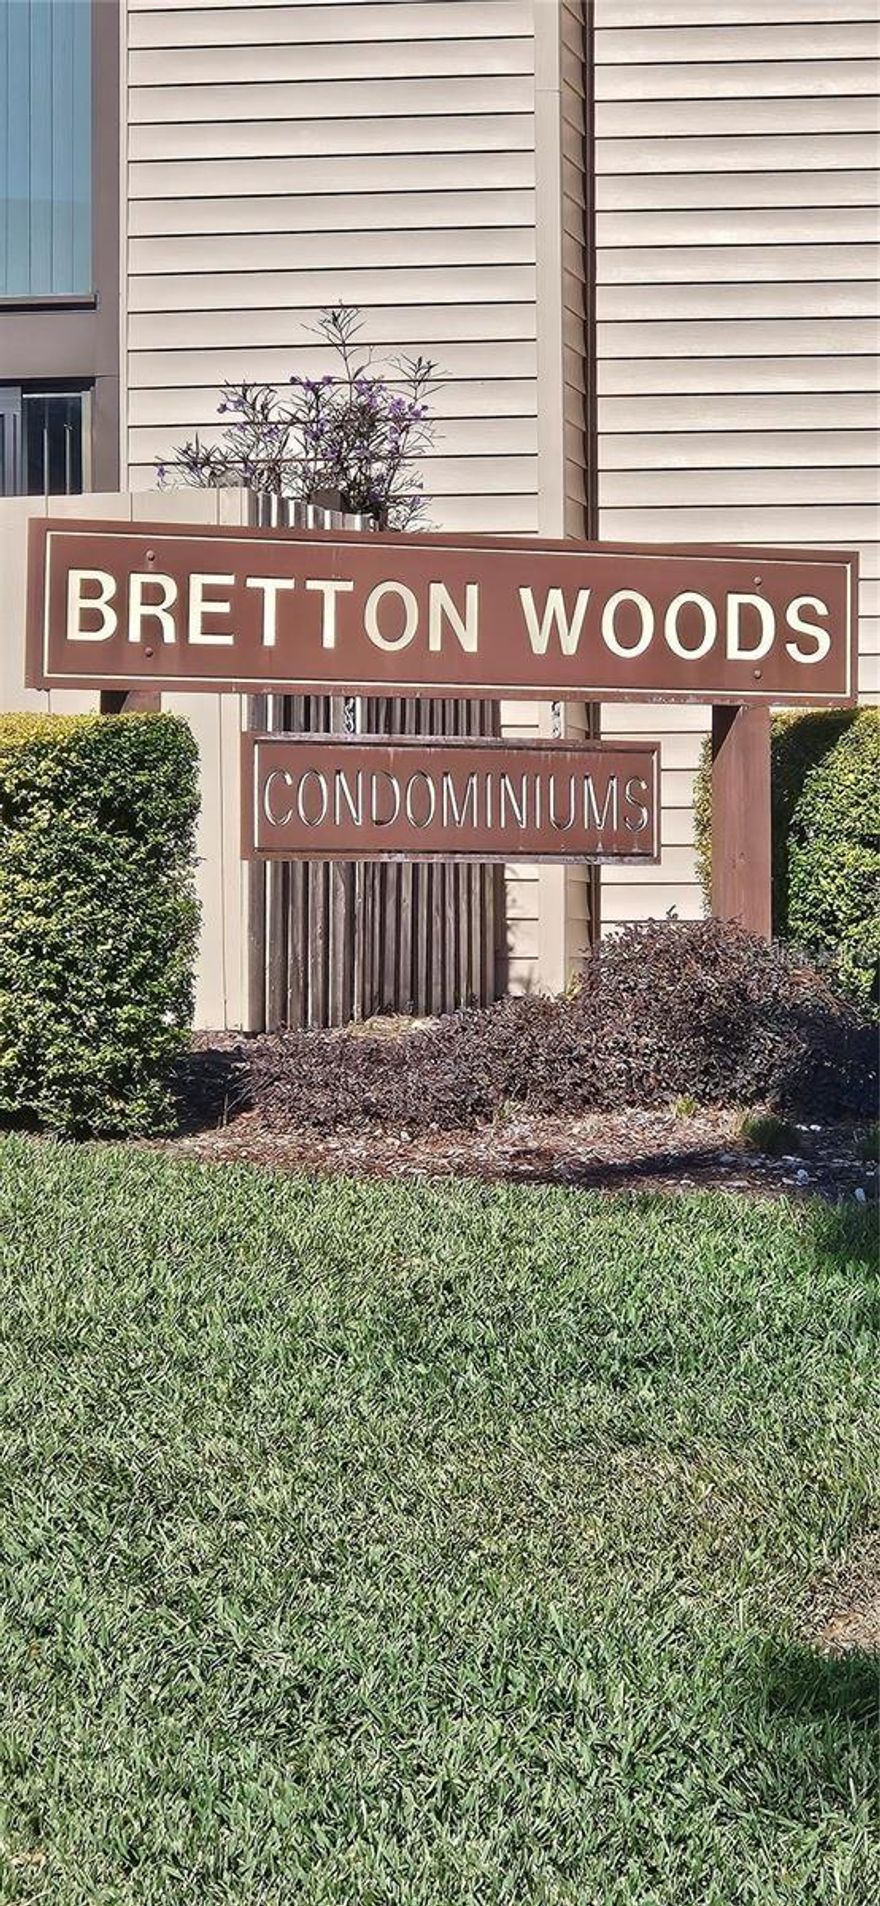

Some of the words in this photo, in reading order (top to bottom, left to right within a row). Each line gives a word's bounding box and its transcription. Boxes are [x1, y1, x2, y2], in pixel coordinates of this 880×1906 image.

[67, 568, 479, 652] BRETTON
[518, 585, 831, 664] WOODS
[264, 770, 648, 832] CONDOMINIUMS
